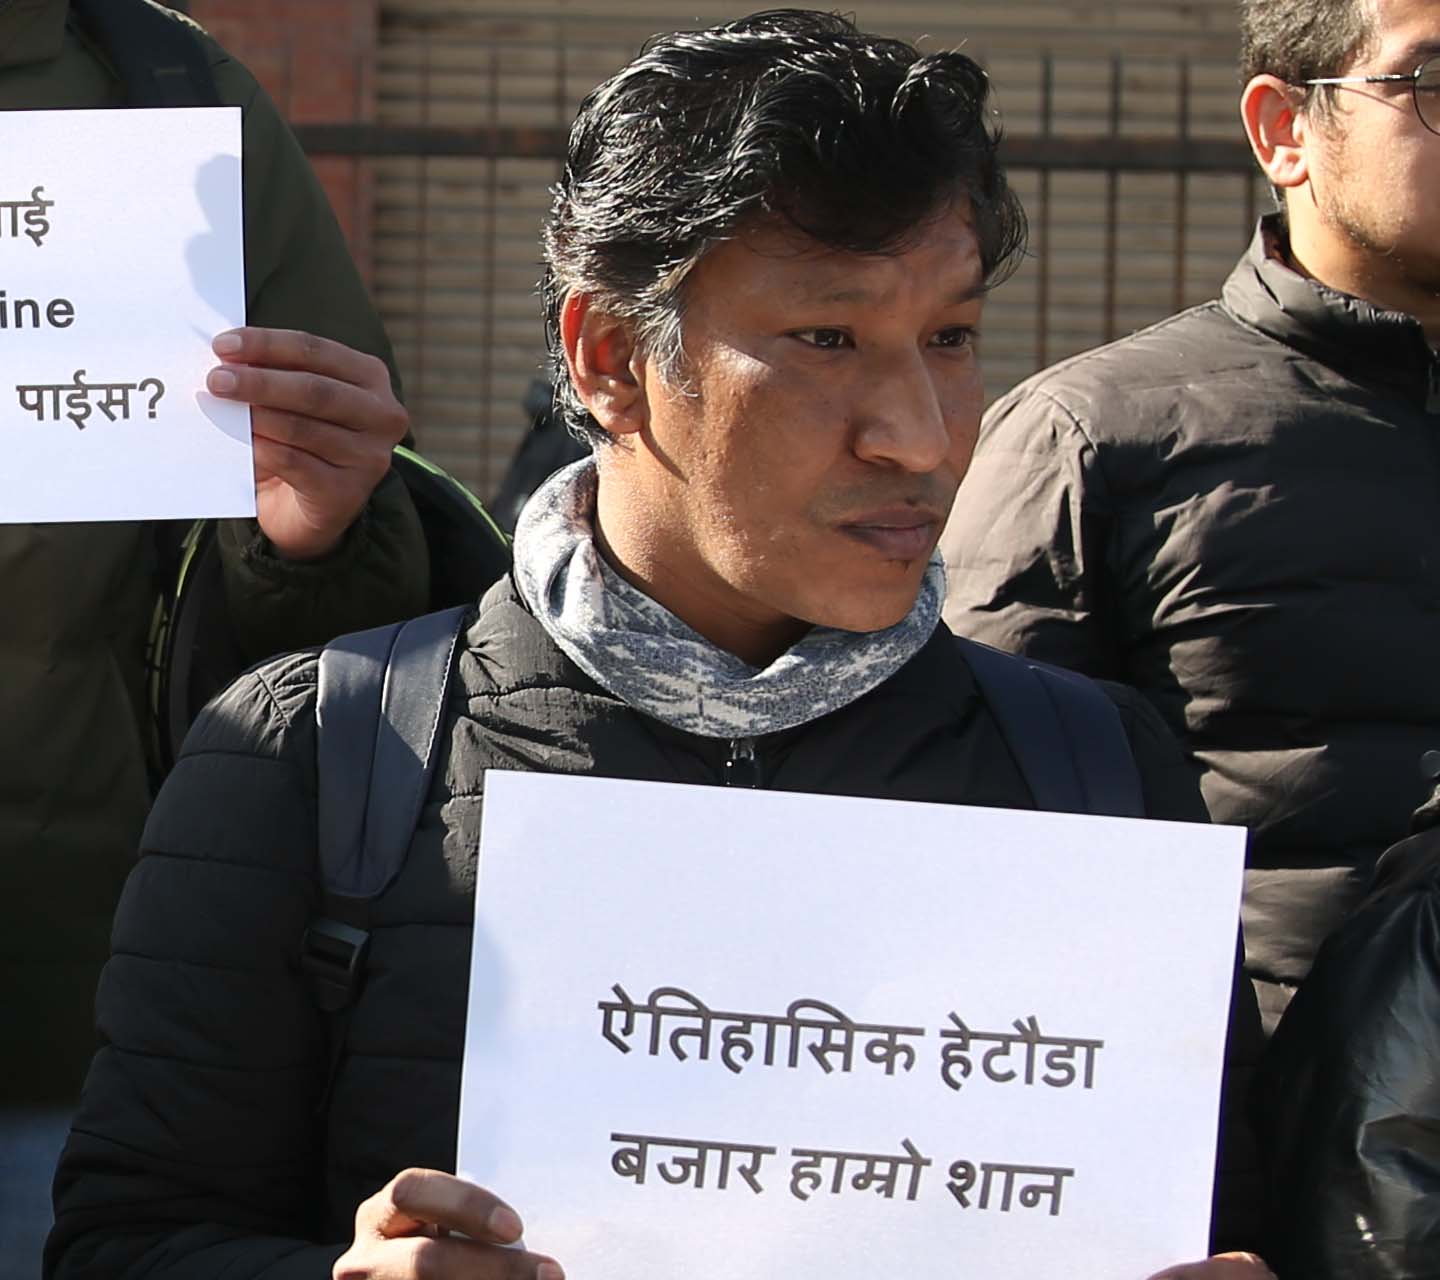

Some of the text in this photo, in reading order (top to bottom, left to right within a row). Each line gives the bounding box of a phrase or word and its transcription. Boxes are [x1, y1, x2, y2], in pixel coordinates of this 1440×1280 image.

[16, 370, 164, 430] पाईस?
[598, 983, 1104, 1091] ऐतिहासिक हेटौडा
[610, 1133, 1074, 1216] बजार हाम्रो शान
